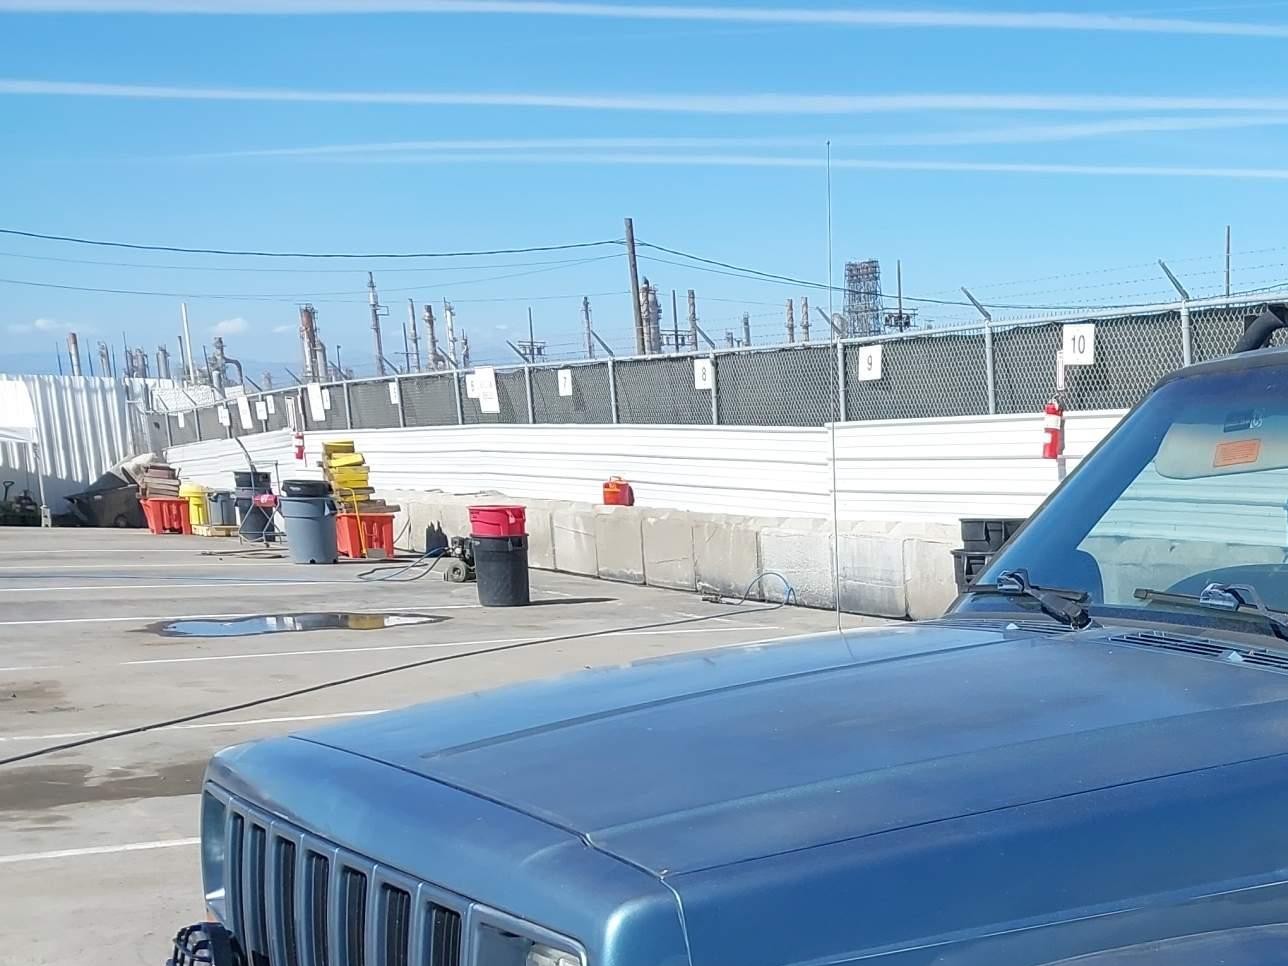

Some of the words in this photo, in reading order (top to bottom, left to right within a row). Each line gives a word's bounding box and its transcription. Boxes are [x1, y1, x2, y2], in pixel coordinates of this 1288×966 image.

[1071, 335, 1086, 354] 10
[867, 355, 873, 371] 9
[701, 367, 708, 382] 8
